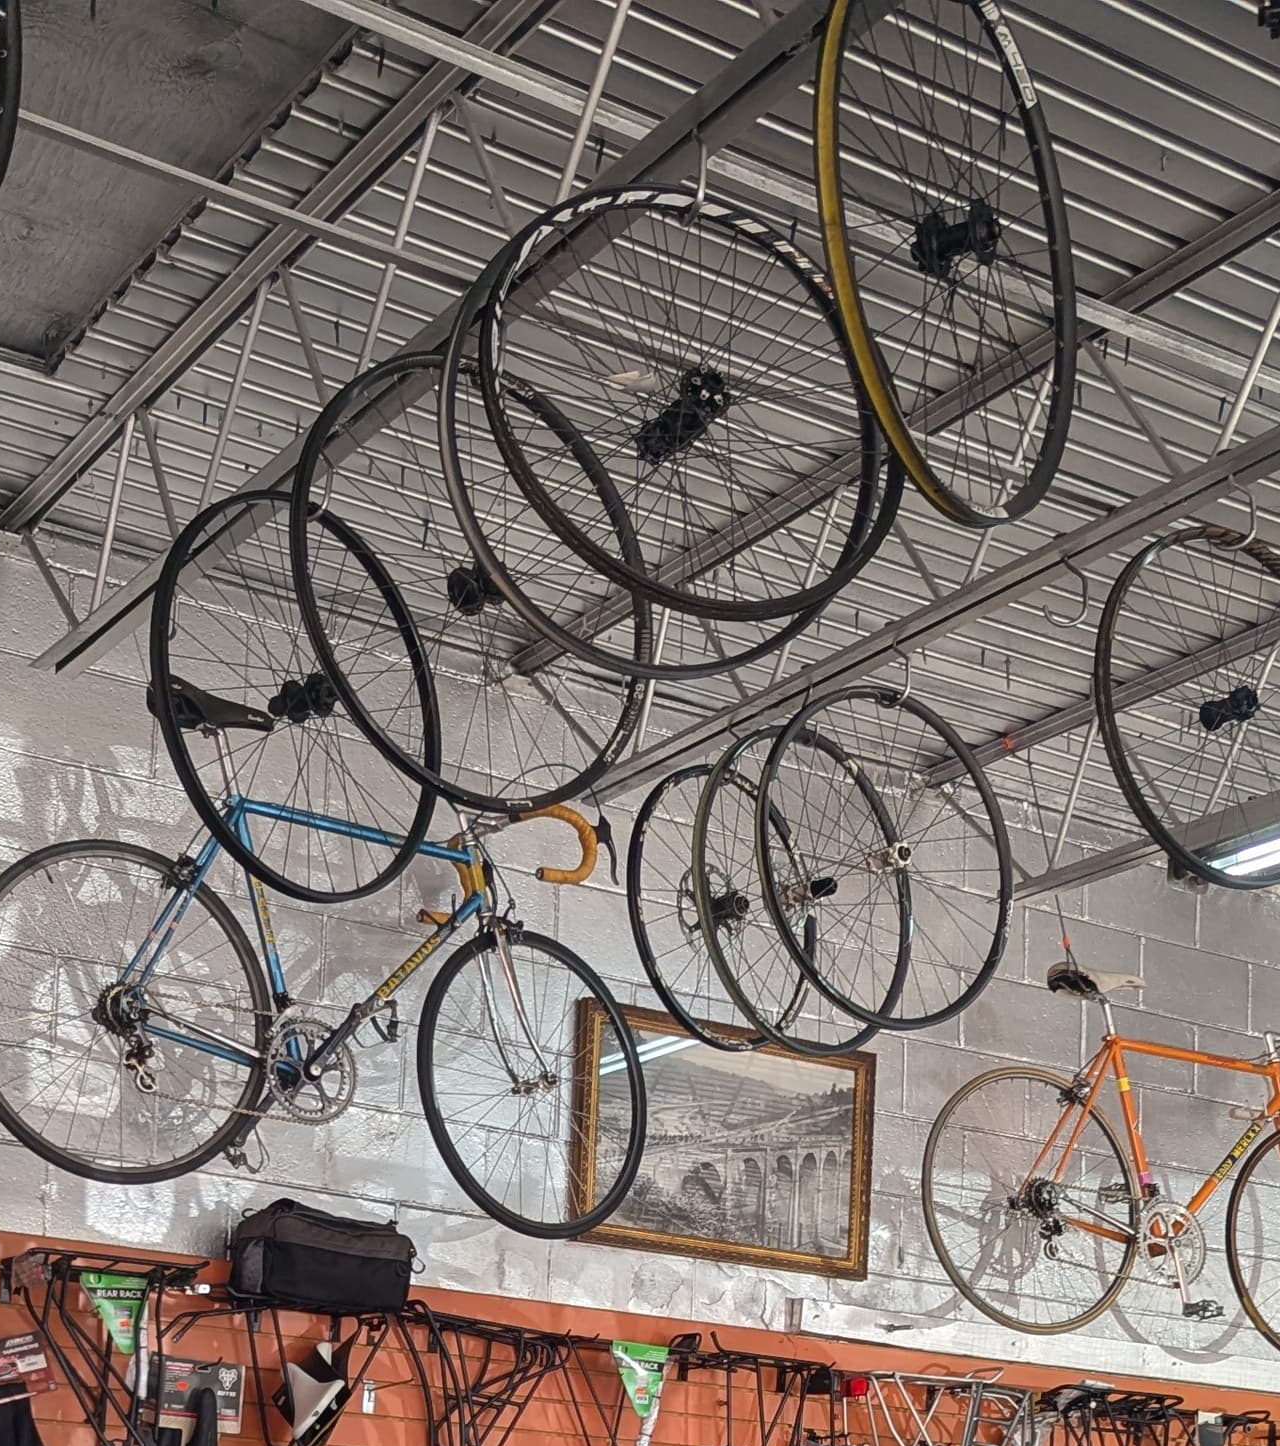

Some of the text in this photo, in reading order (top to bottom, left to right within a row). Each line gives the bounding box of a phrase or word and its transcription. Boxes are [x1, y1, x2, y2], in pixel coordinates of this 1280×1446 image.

[377, 934, 441, 999] BATAVUS
[96, 1289, 144, 1298] REAR RACK
